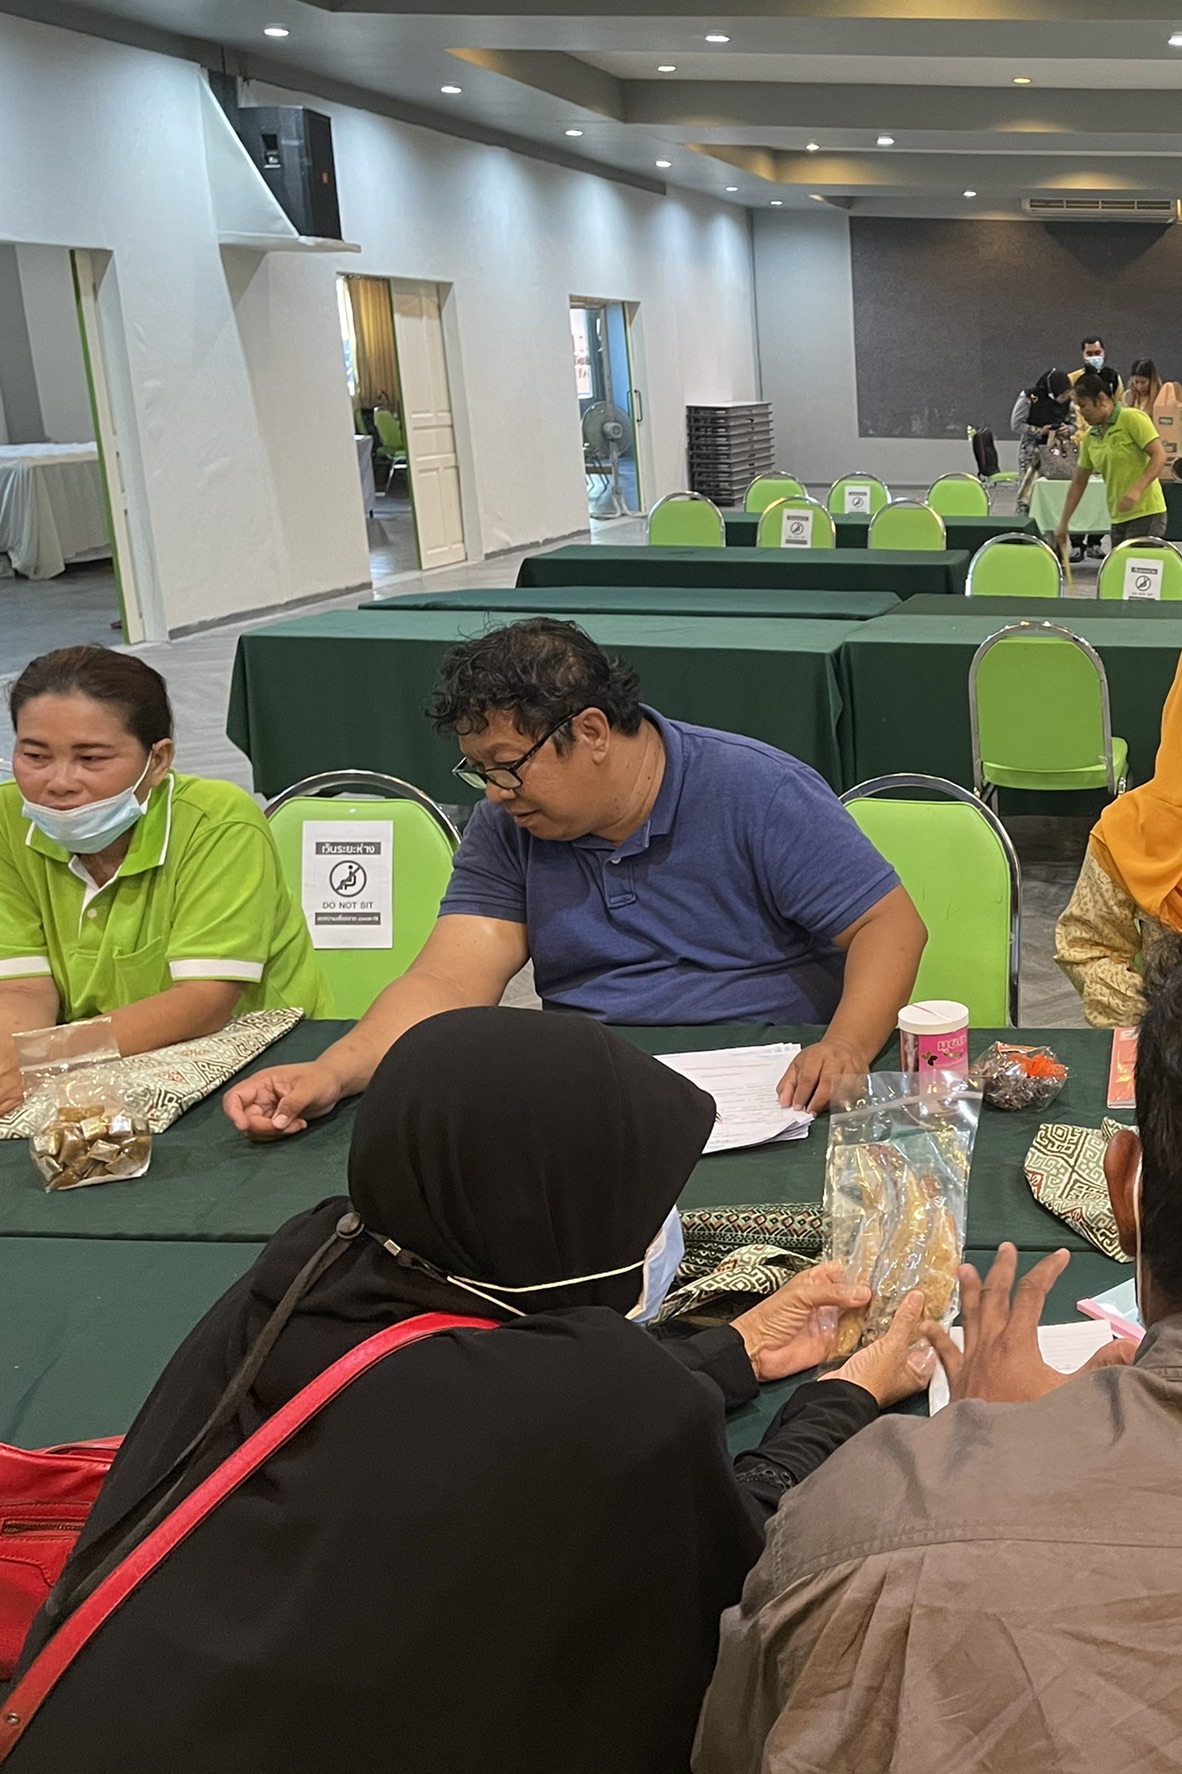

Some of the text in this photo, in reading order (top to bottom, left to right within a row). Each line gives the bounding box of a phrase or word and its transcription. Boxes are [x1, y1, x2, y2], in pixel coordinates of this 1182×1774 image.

[322, 901, 374, 910] DO NOT SIT
